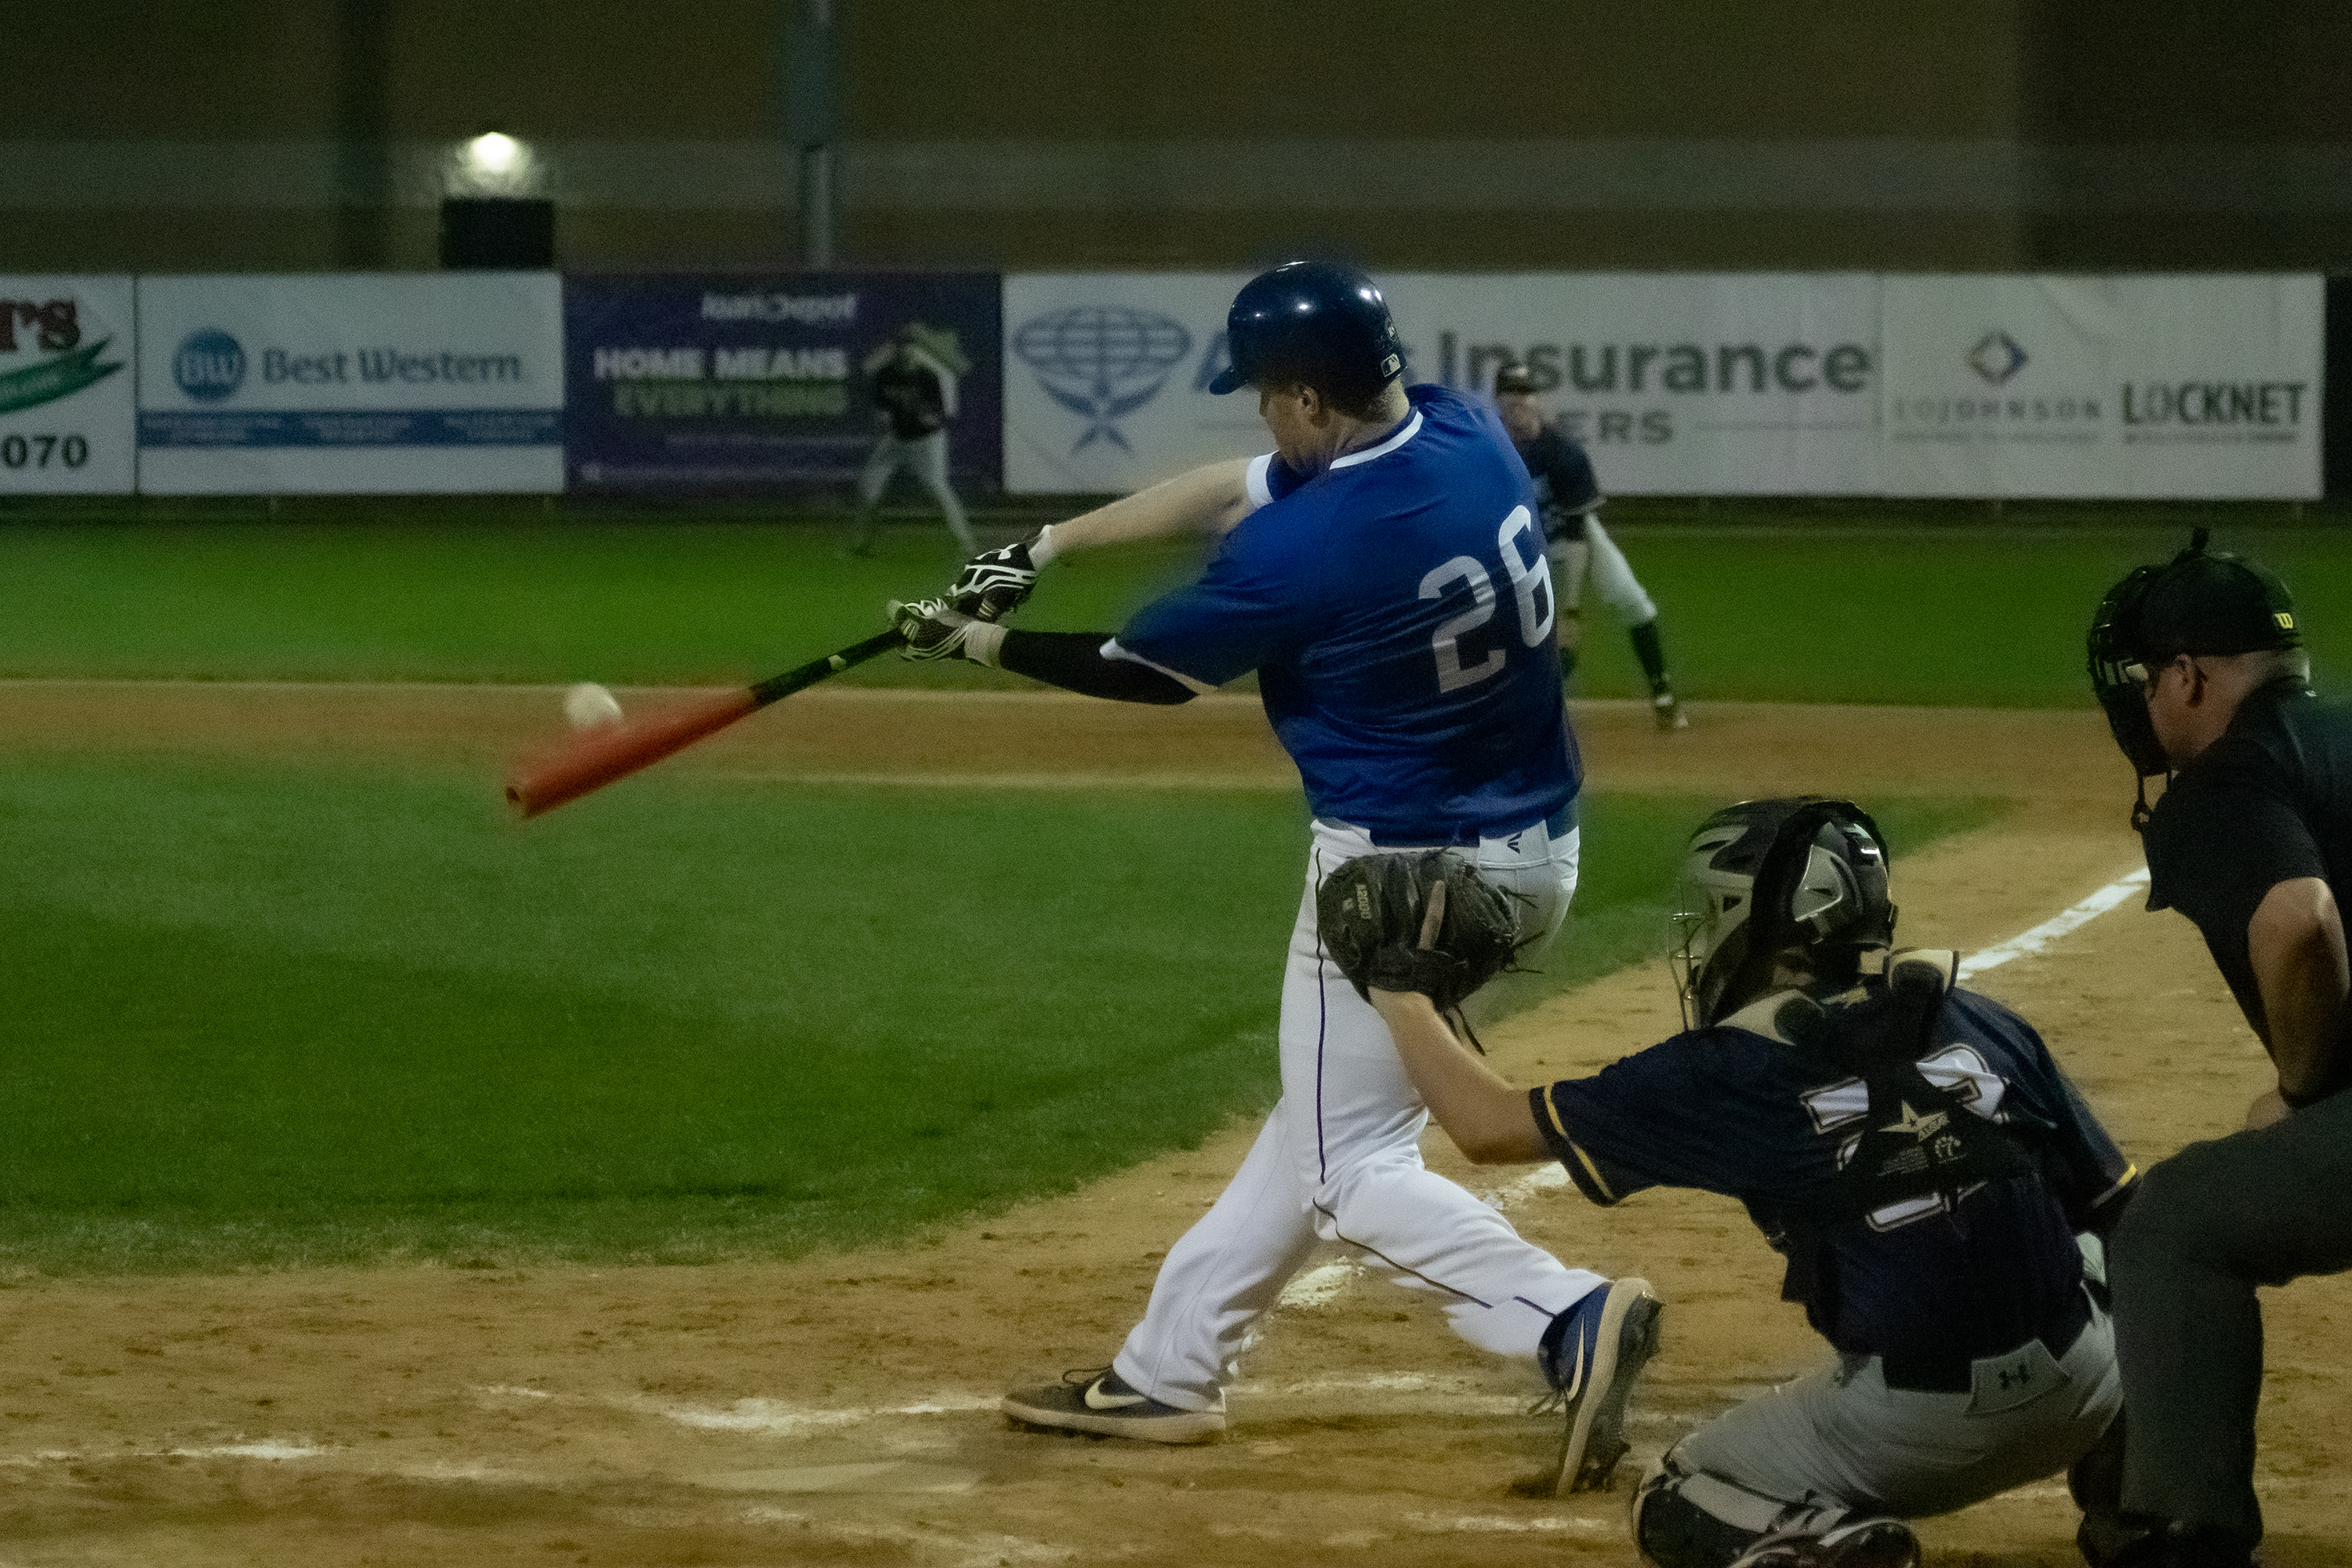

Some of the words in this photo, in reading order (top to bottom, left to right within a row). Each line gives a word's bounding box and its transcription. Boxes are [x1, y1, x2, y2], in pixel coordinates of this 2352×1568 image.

[180, 351, 239, 386] BW
[263, 348, 346, 384] Best
[358, 350, 521, 384] Western
[593, 347, 702, 379] HOME
[714, 347, 848, 379] MEANS
[1438, 330, 1872, 392] Insurance
[615, 383, 849, 416] EVERYTHING
[2122, 383, 2307, 424] LOCKNET
[2, 435, 89, 469] 070
[1418, 505, 1554, 693] 26
